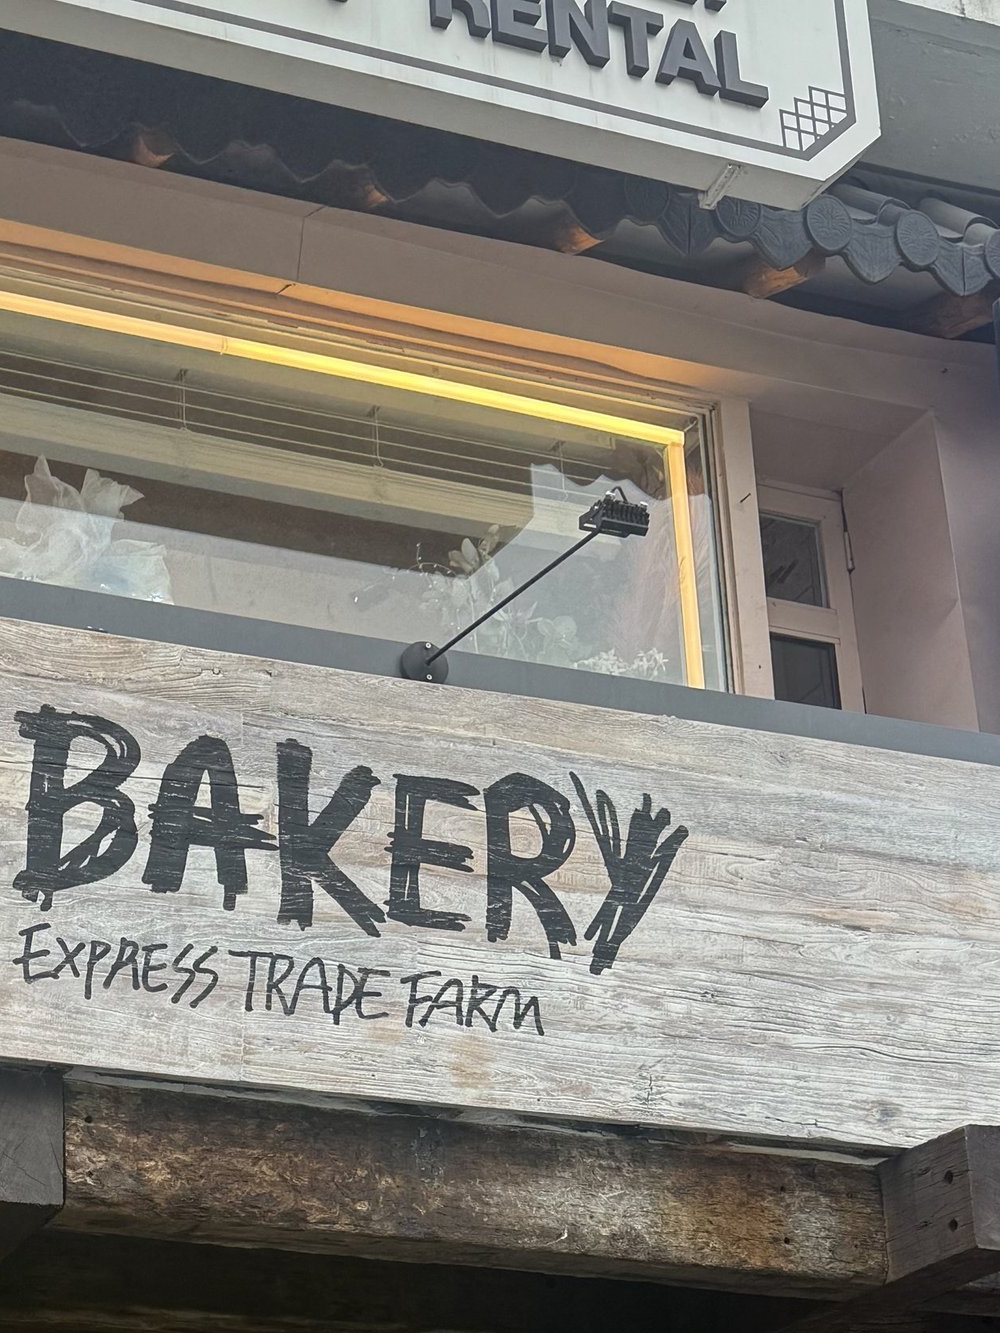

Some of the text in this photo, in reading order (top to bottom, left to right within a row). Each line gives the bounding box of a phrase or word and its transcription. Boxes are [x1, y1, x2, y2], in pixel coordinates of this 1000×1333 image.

[12, 703, 689, 975] BAKERY
[13, 923, 219, 1009] EXPRESS
[228, 949, 390, 1026] TRADE
